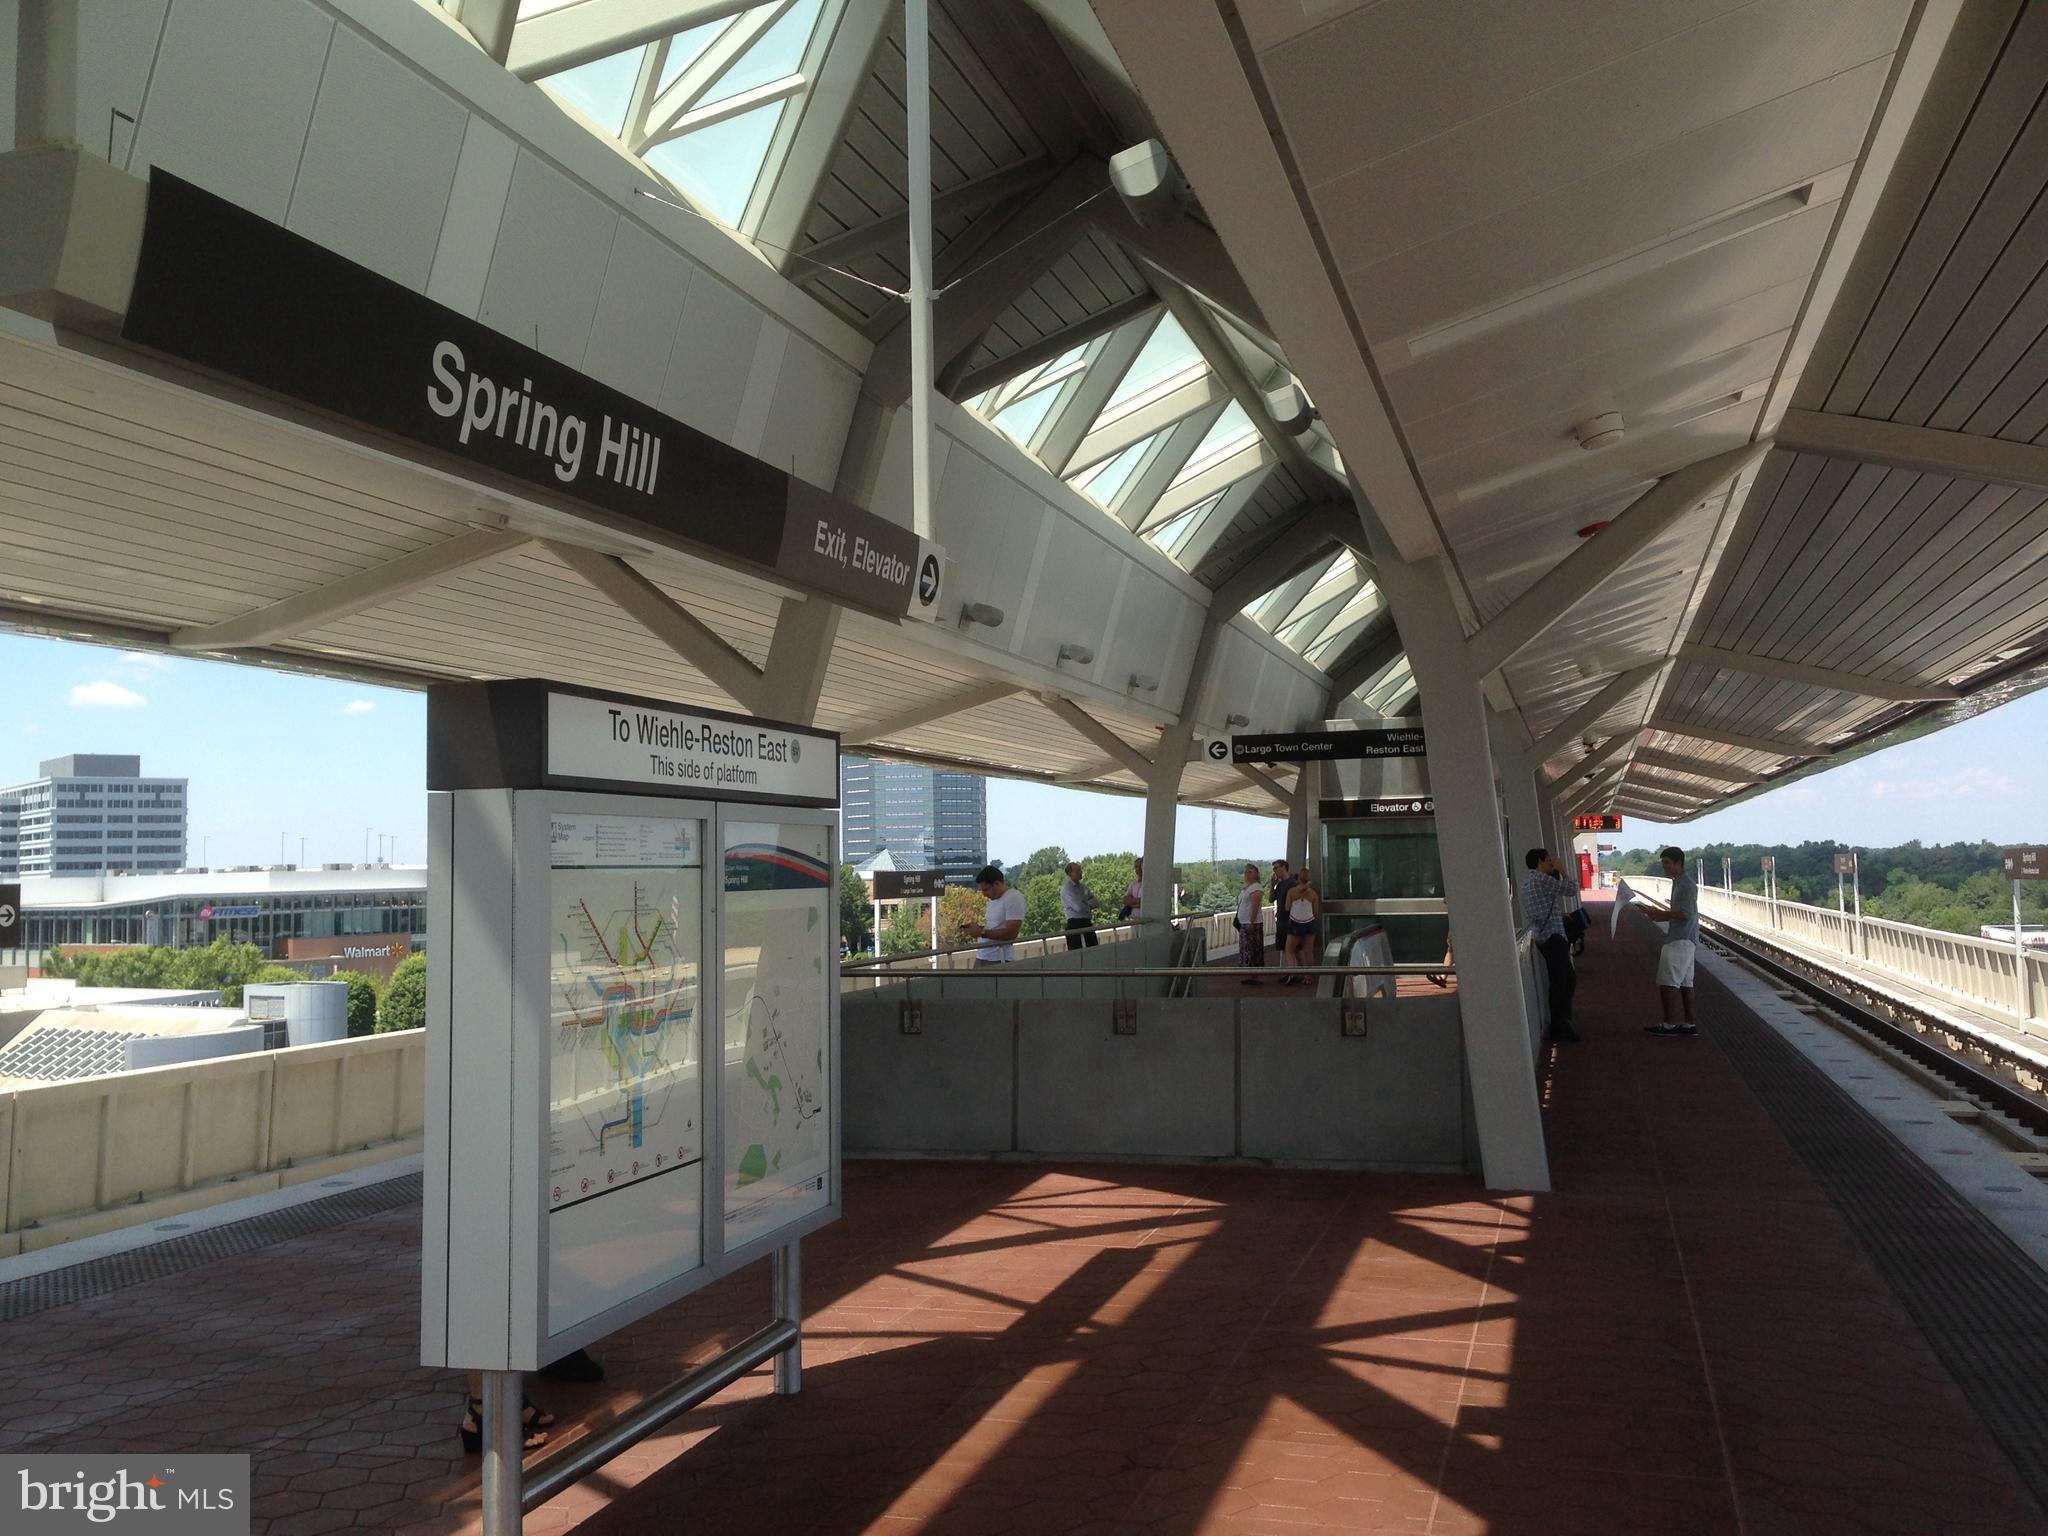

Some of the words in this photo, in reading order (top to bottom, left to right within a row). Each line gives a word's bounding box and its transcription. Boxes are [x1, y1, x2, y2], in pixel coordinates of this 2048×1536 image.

[427, 340, 587, 483] Spring
[595, 413, 662, 496] Hill
[813, 519, 849, 569] Exit,
[852, 535, 911, 588] Elevator
[608, 709, 630, 743] To
[636, 713, 753, 759] Wiehle-Reston
[758, 733, 788, 764] East
[1386, 732, 1424, 742] Wiehle-
[1244, 744, 1272, 755] Largo
[1274, 743, 1299, 753] Town
[1301, 742, 1334, 752] Center
[1366, 745, 1400, 755] Reston
[1402, 744, 1425, 753] East
[650, 754, 674, 777] This
[677, 756, 700, 780] side
[703, 761, 714, 780] of
[716, 762, 758, 786] platform
[1370, 803, 1409, 813] Elevator
[557, 821, 577, 832] System
[343, 945, 391, 959] Walmart
